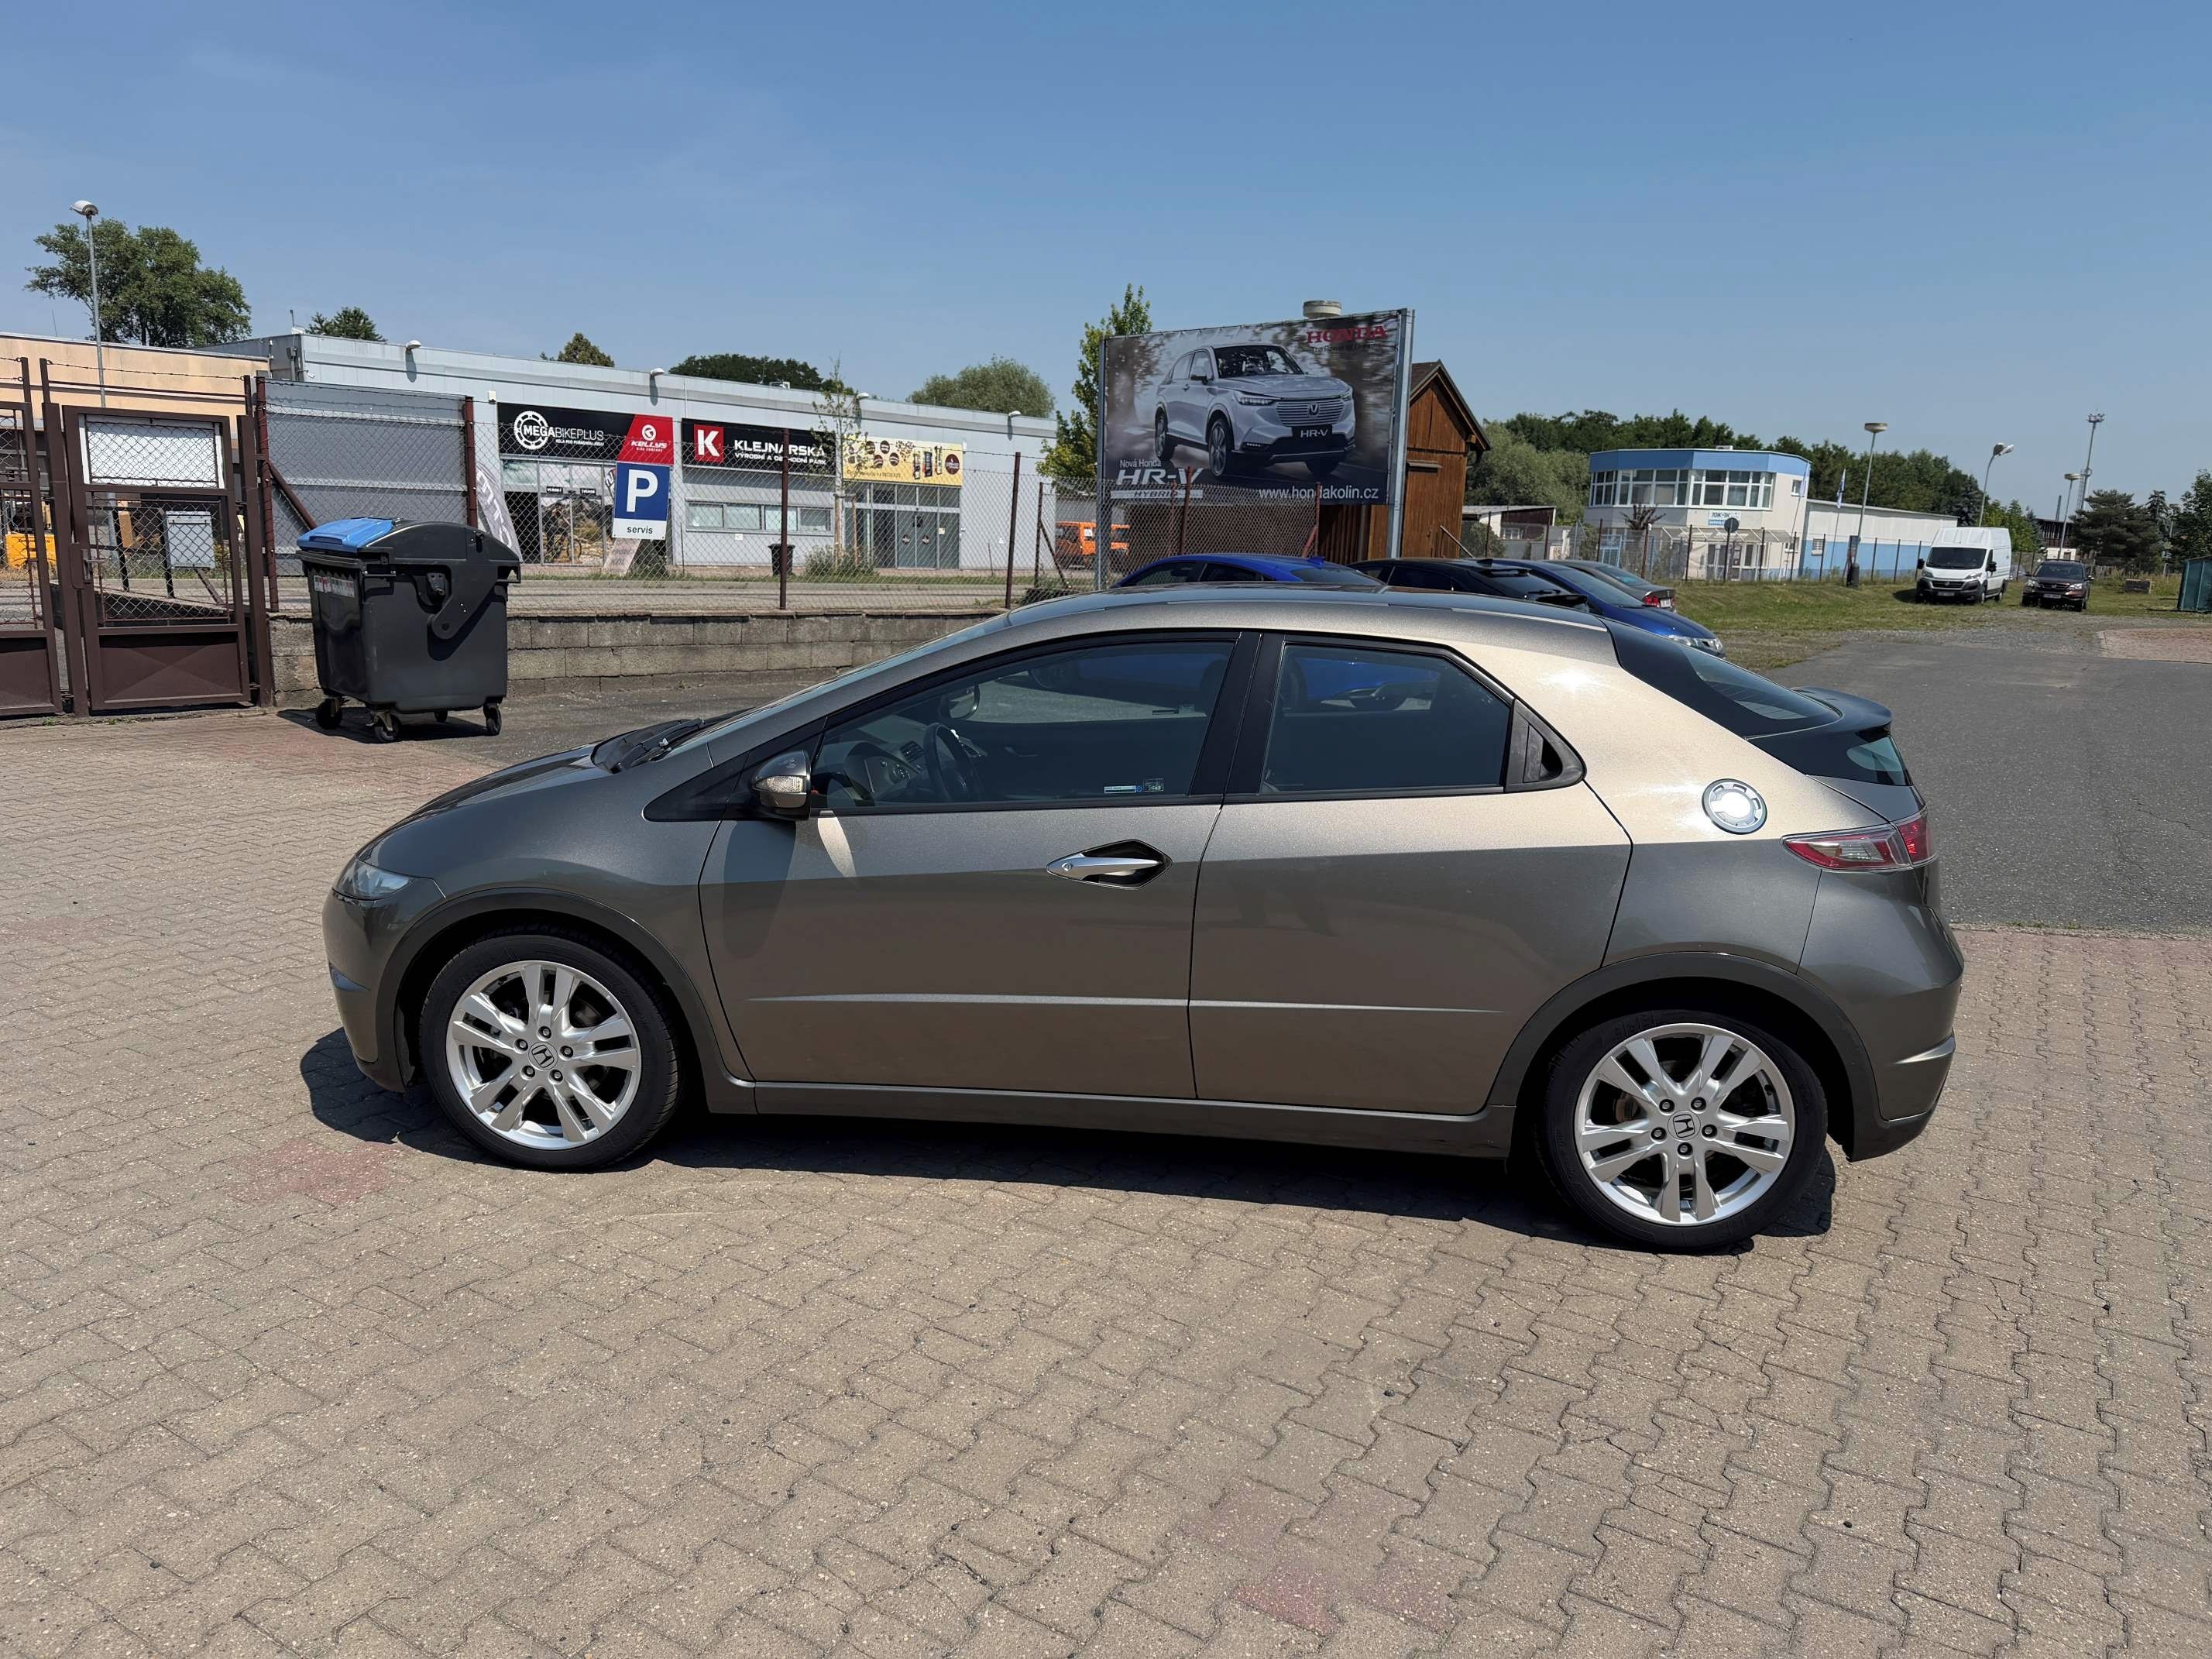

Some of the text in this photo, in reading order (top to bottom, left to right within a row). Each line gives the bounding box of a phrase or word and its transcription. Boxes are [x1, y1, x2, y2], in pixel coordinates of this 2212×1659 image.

[1306, 325, 1389, 344] HONDA
[523, 424, 604, 441] MEGABIKEPLUS
[697, 429, 720, 457] K
[774, 455, 808, 464] OBHODNÍ
[1120, 458, 1162, 468] Nová Honda
[1115, 467, 1204, 486] HR-V
[626, 469, 658, 513] P
[627, 526, 653, 534] servis
